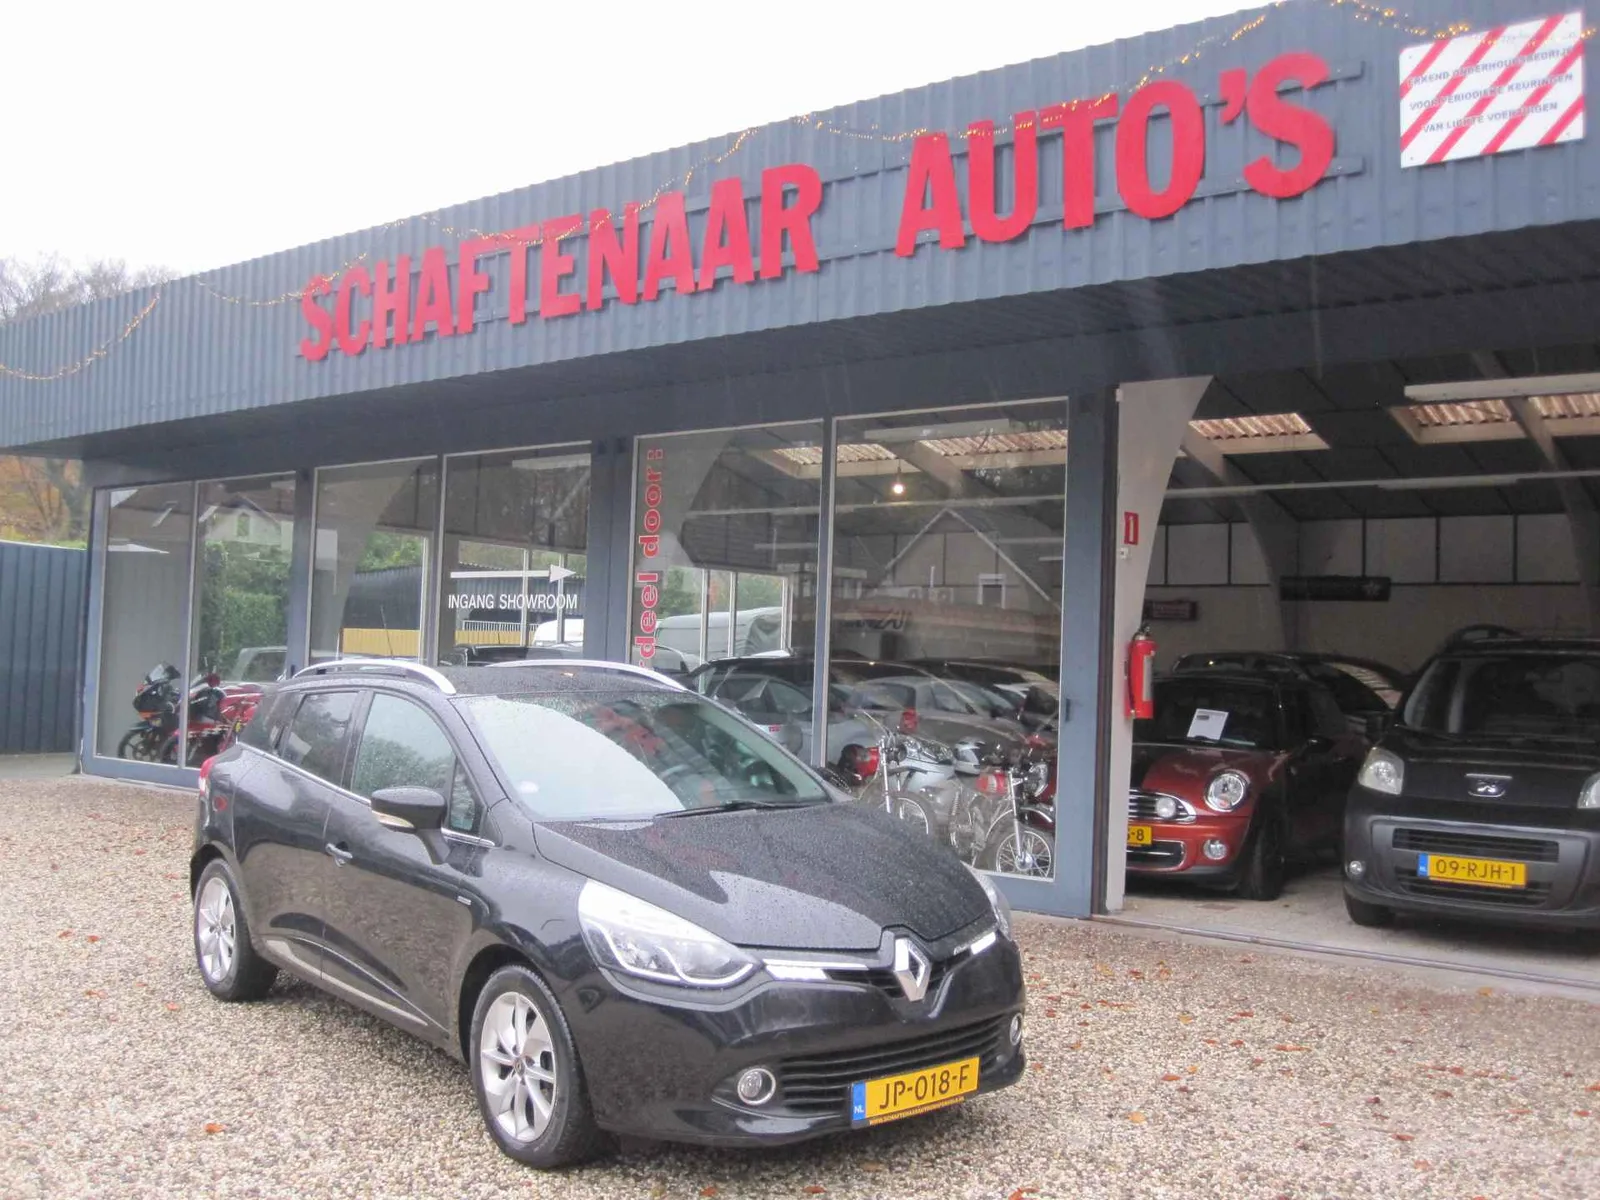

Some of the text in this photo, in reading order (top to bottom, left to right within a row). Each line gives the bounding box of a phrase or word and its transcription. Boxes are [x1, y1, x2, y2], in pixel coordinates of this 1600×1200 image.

[1408, 70, 1450, 87] ERKEND
[1409, 96, 1441, 111] VOOR
[1507, 73, 1573, 92] KEURINGEN
[1423, 101, 1558, 133] VAN LICHTE VOERTUIGEN
[300, 51, 1336, 361] SCHAFTENAAR AUTO'S
[448, 593, 578, 609] INGANG SHOWROOM
[1435, 858, 1516, 881] 09-RJH-1
[879, 1064, 970, 1110] JP-018-F
[853, 1104, 864, 1114] NL
